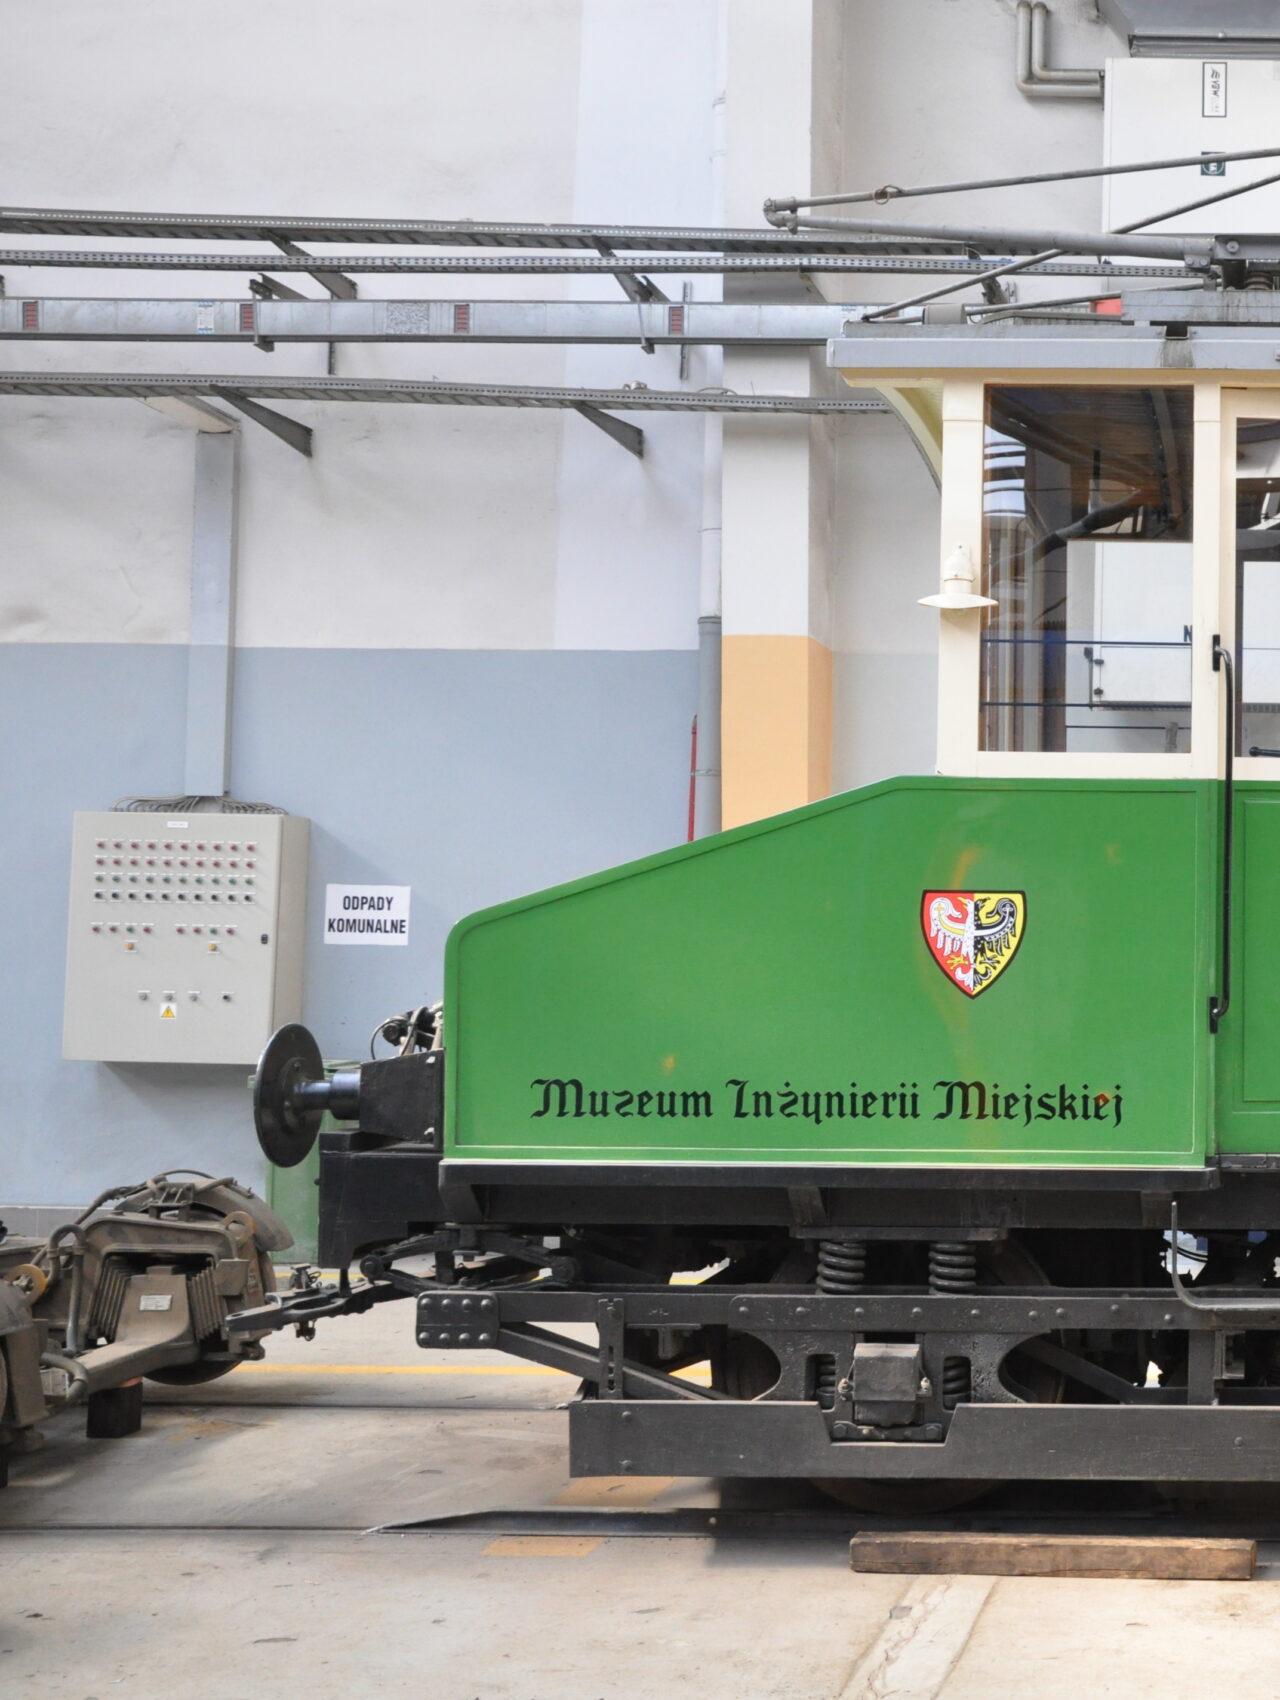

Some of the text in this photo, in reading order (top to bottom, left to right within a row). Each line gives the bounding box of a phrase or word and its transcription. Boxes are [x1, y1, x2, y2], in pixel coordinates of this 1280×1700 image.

[343, 895, 394, 911] ODPADY
[327, 918, 406, 934] KOMUNALNE
[530, 1078, 1123, 1128] Muzeum Inżynierii Miejskiej
